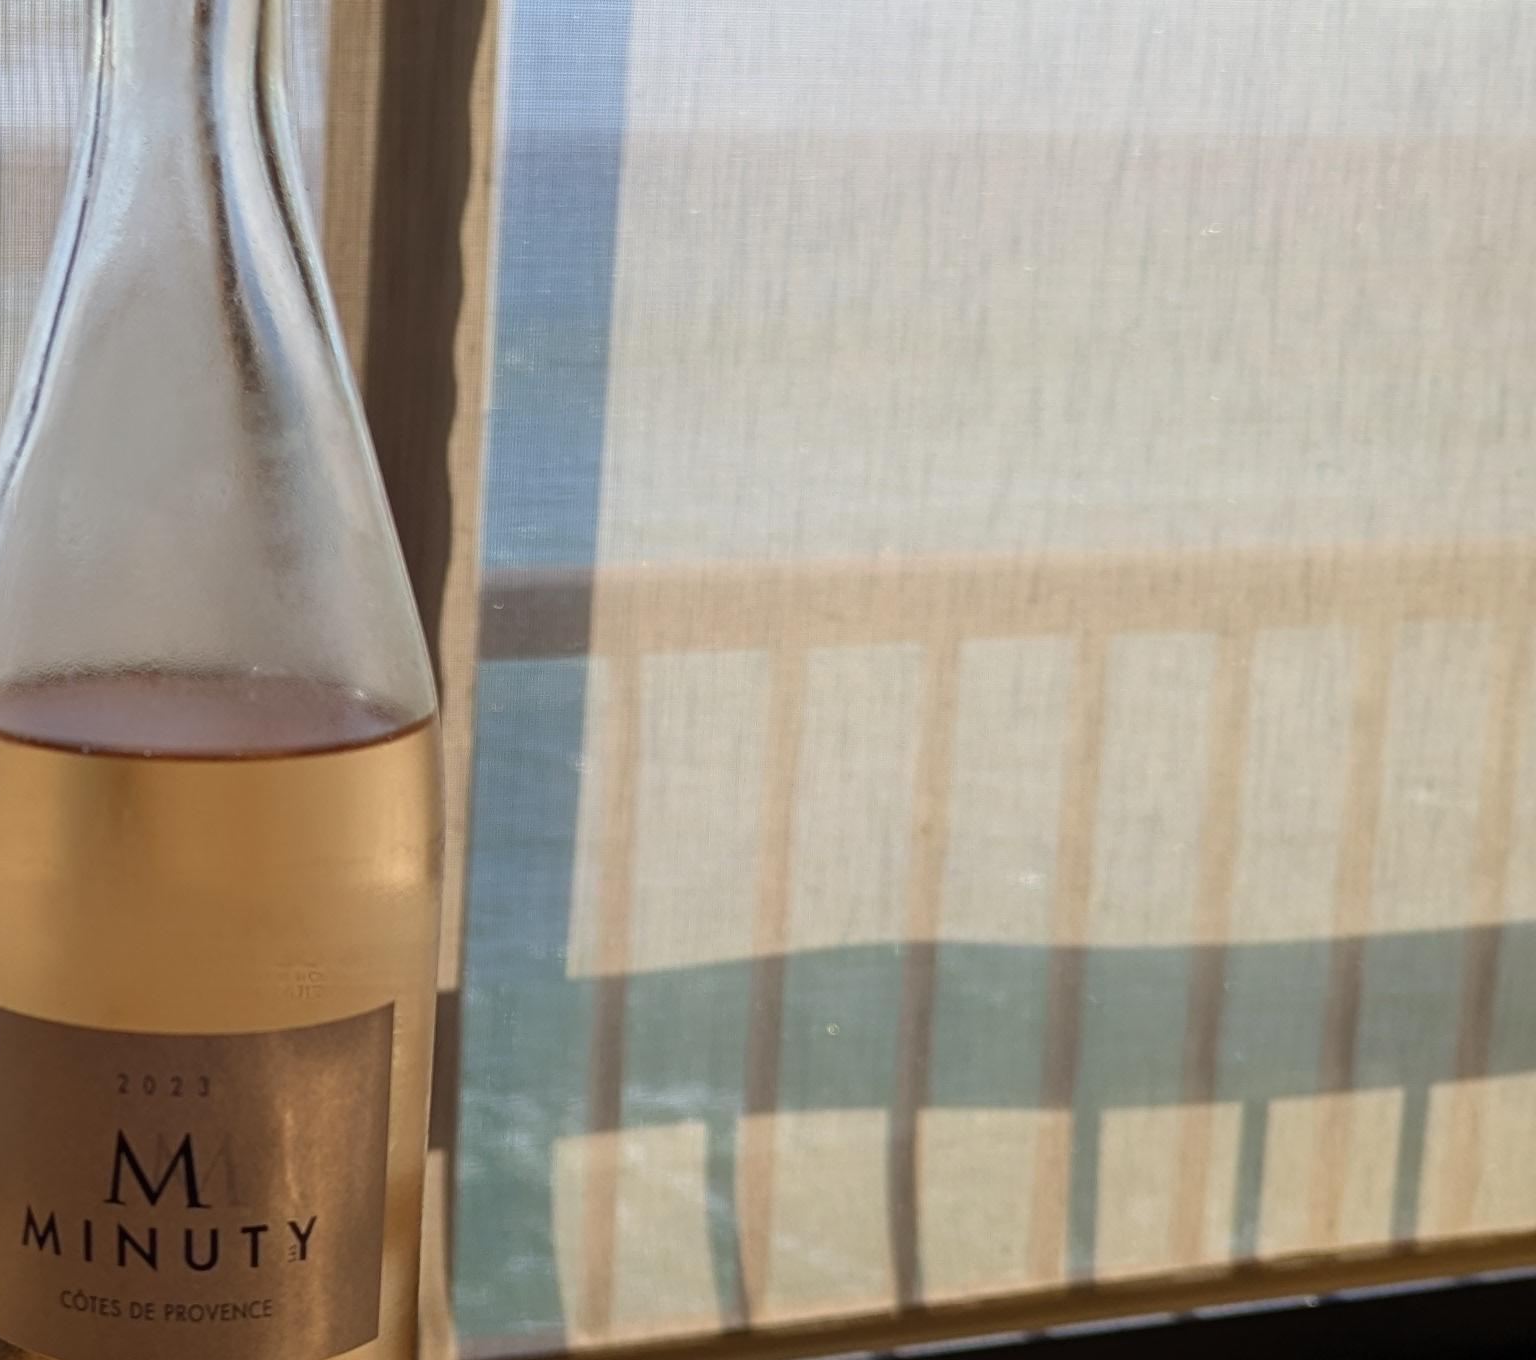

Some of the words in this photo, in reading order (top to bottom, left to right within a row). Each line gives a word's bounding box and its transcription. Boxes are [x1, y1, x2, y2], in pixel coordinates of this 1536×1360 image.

[117, 1074, 211, 1097] 2023
[104, 1129, 213, 1209] M
[21, 1205, 318, 1272] MINUTY
[60, 1289, 121, 1318] CÔTES
[129, 1300, 155, 1321] DE
[164, 1299, 273, 1323] PROVENCE
